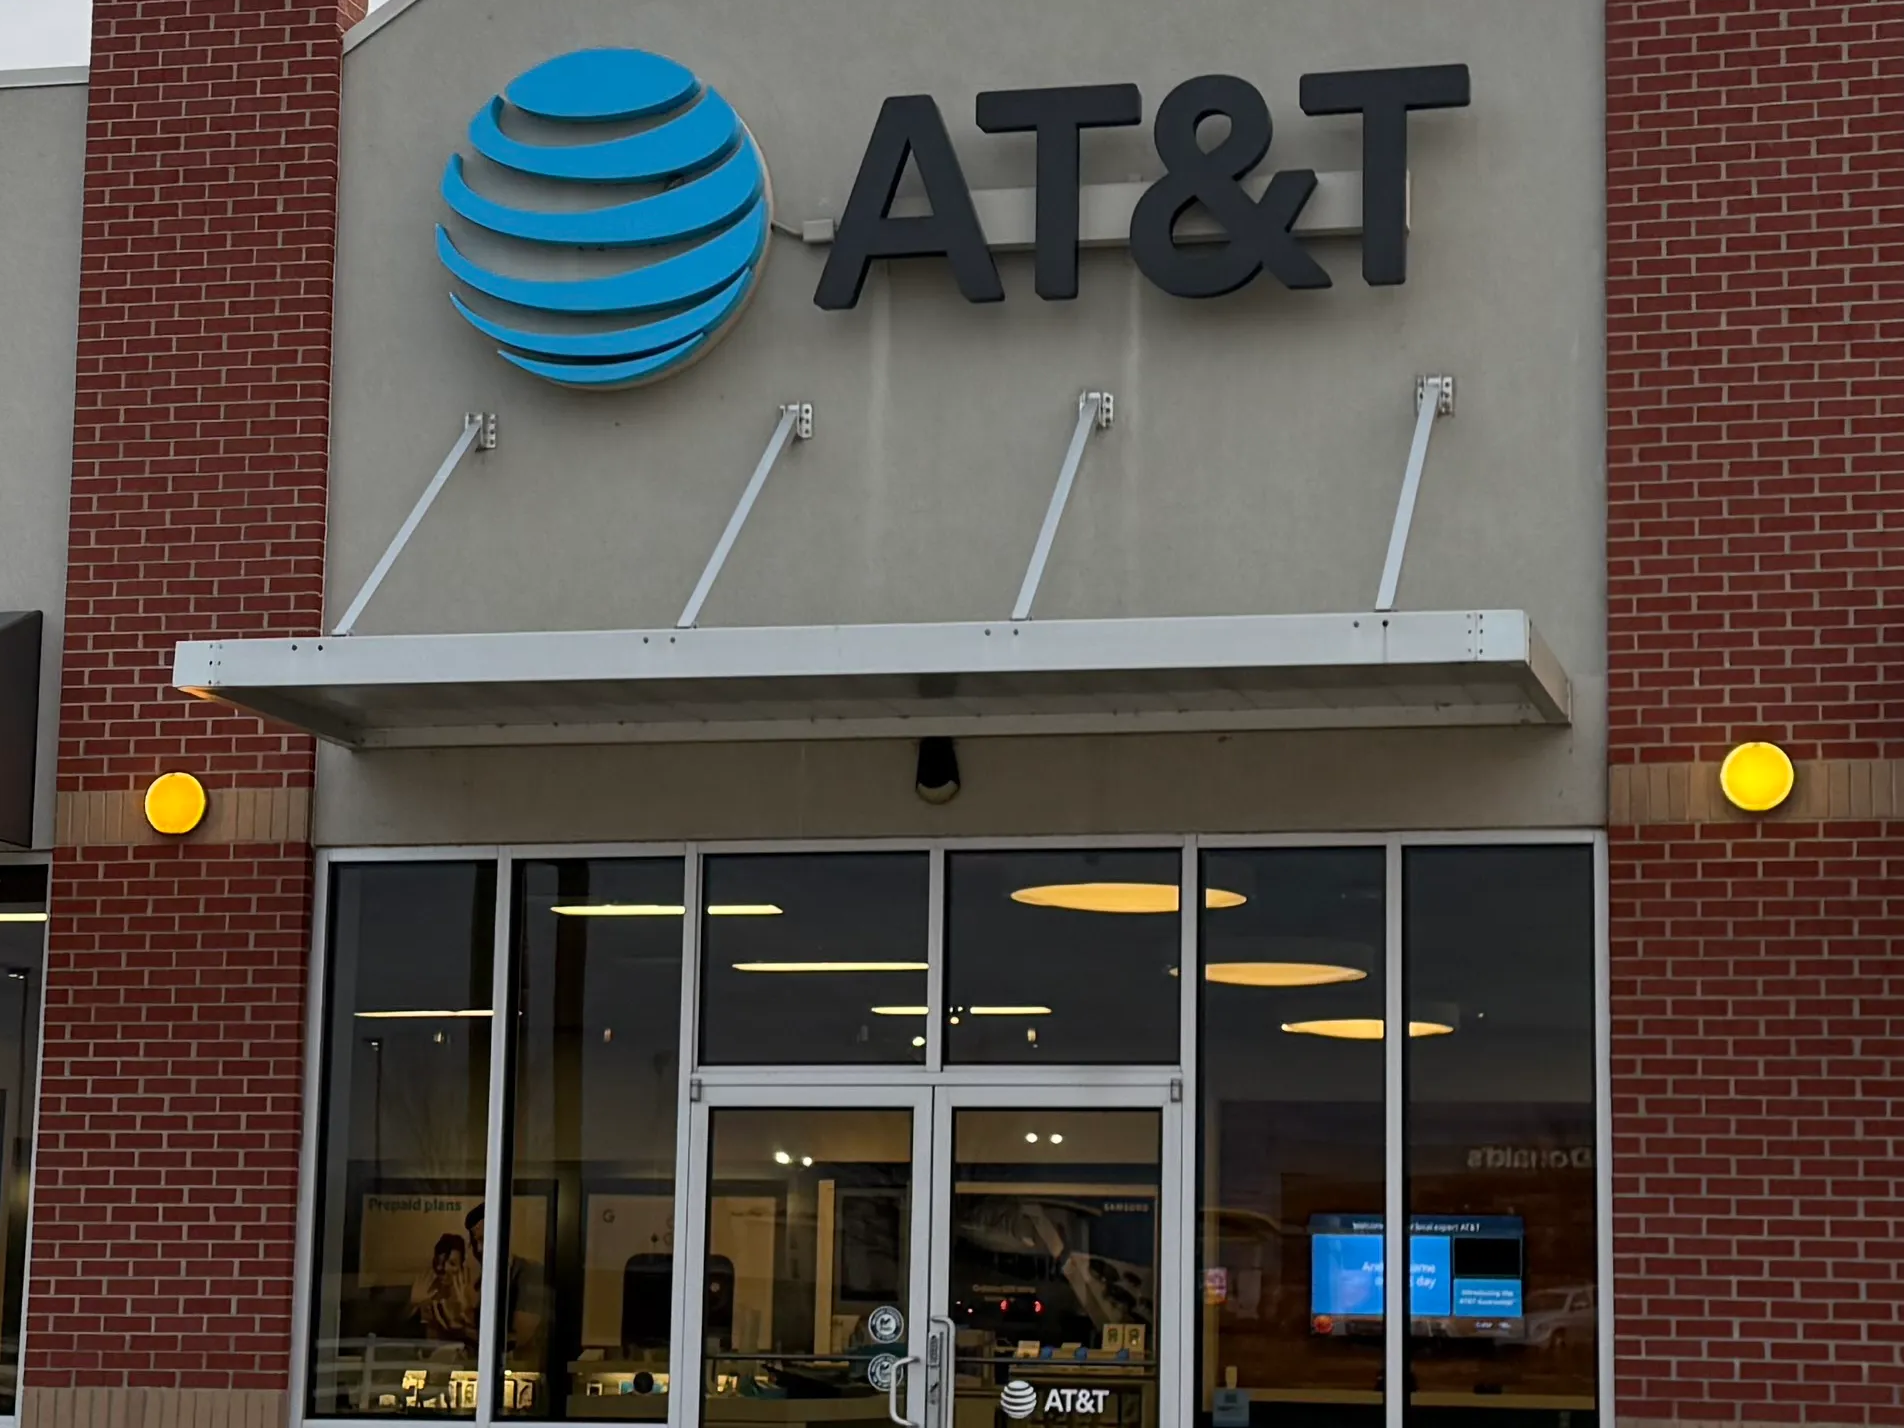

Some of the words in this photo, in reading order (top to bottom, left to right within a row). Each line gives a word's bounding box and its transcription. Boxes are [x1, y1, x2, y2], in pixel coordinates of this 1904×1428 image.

[814, 63, 1471, 311] AT&T
[369, 1197, 421, 1214] Prepaid
[425, 1198, 462, 1213] plans
[1044, 1388, 1110, 1414] AT&T
